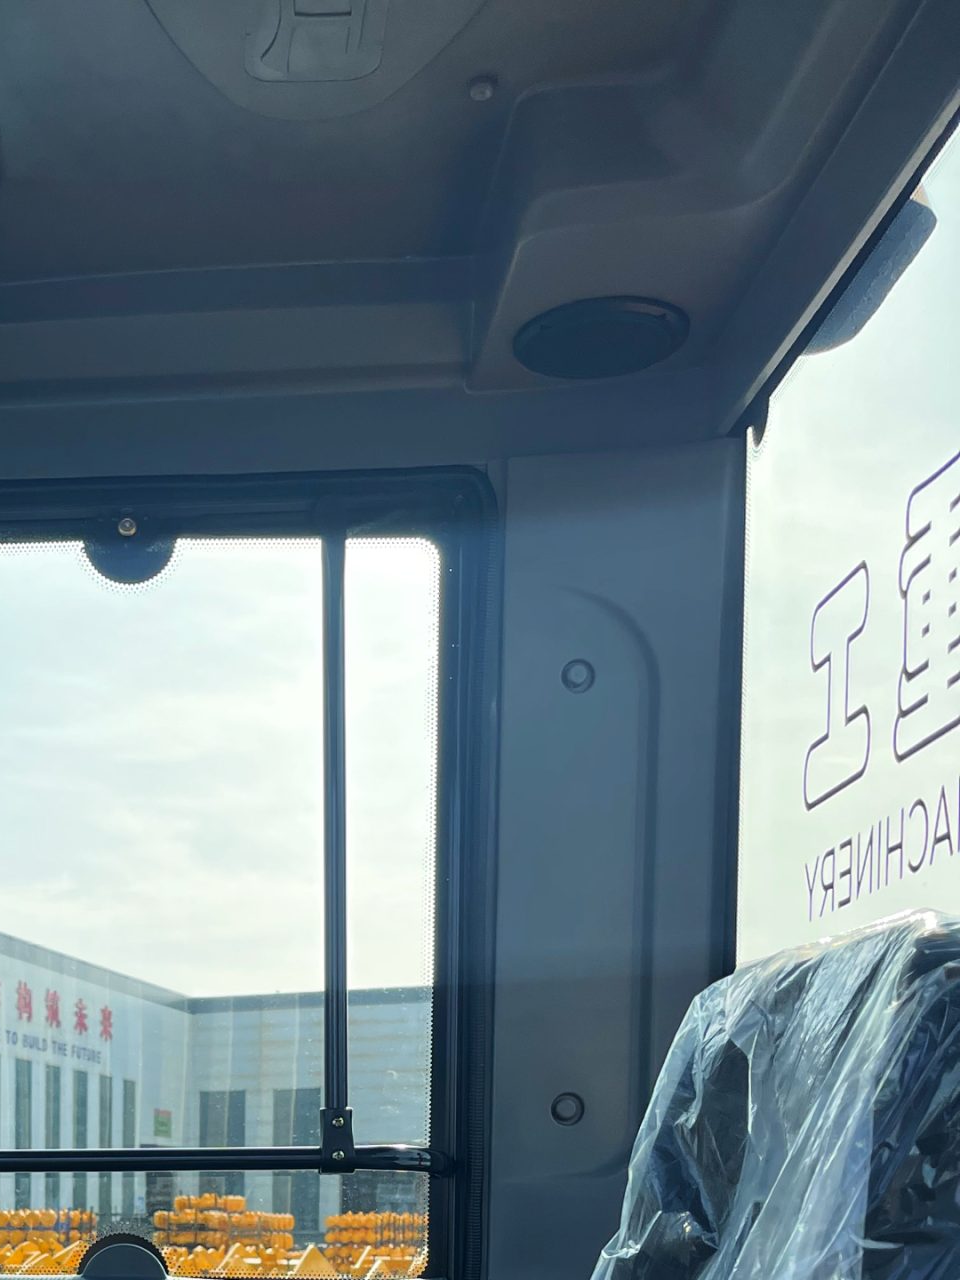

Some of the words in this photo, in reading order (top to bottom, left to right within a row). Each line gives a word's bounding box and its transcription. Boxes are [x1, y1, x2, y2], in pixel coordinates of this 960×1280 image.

[6, 1029, 19, 1046] TO
[22, 1033, 48, 1053] BUILD
[51, 1040, 68, 1058] THE
[71, 1044, 103, 1065] FUTURE
